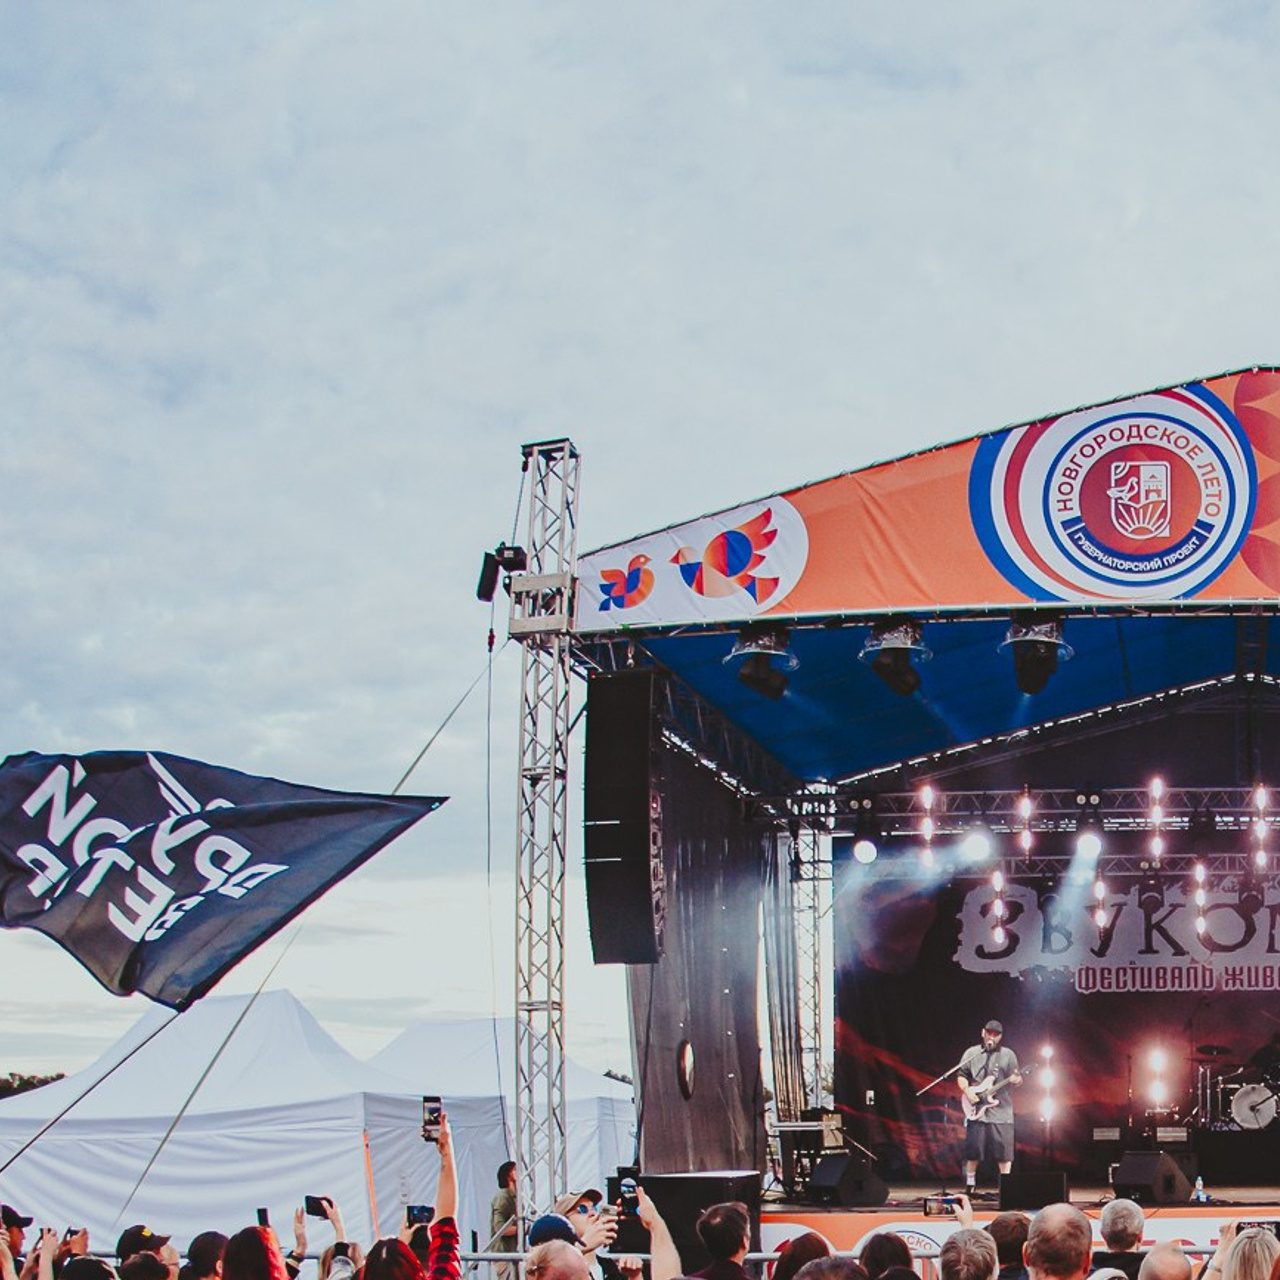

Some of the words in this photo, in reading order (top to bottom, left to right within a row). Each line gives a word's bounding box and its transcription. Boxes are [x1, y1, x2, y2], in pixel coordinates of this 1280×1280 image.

[1057, 424, 1203, 512] НОВГОРОДСКОЕ
[1198, 461, 1222, 517] ЛЕТО
[1074, 532, 1162, 571] ГУБЕРНАТОРСКИЙ
[1163, 537, 1200, 566] ПРОЕКТ
[1077, 965, 1215, 992] ФЕСТИВАЛЬ
